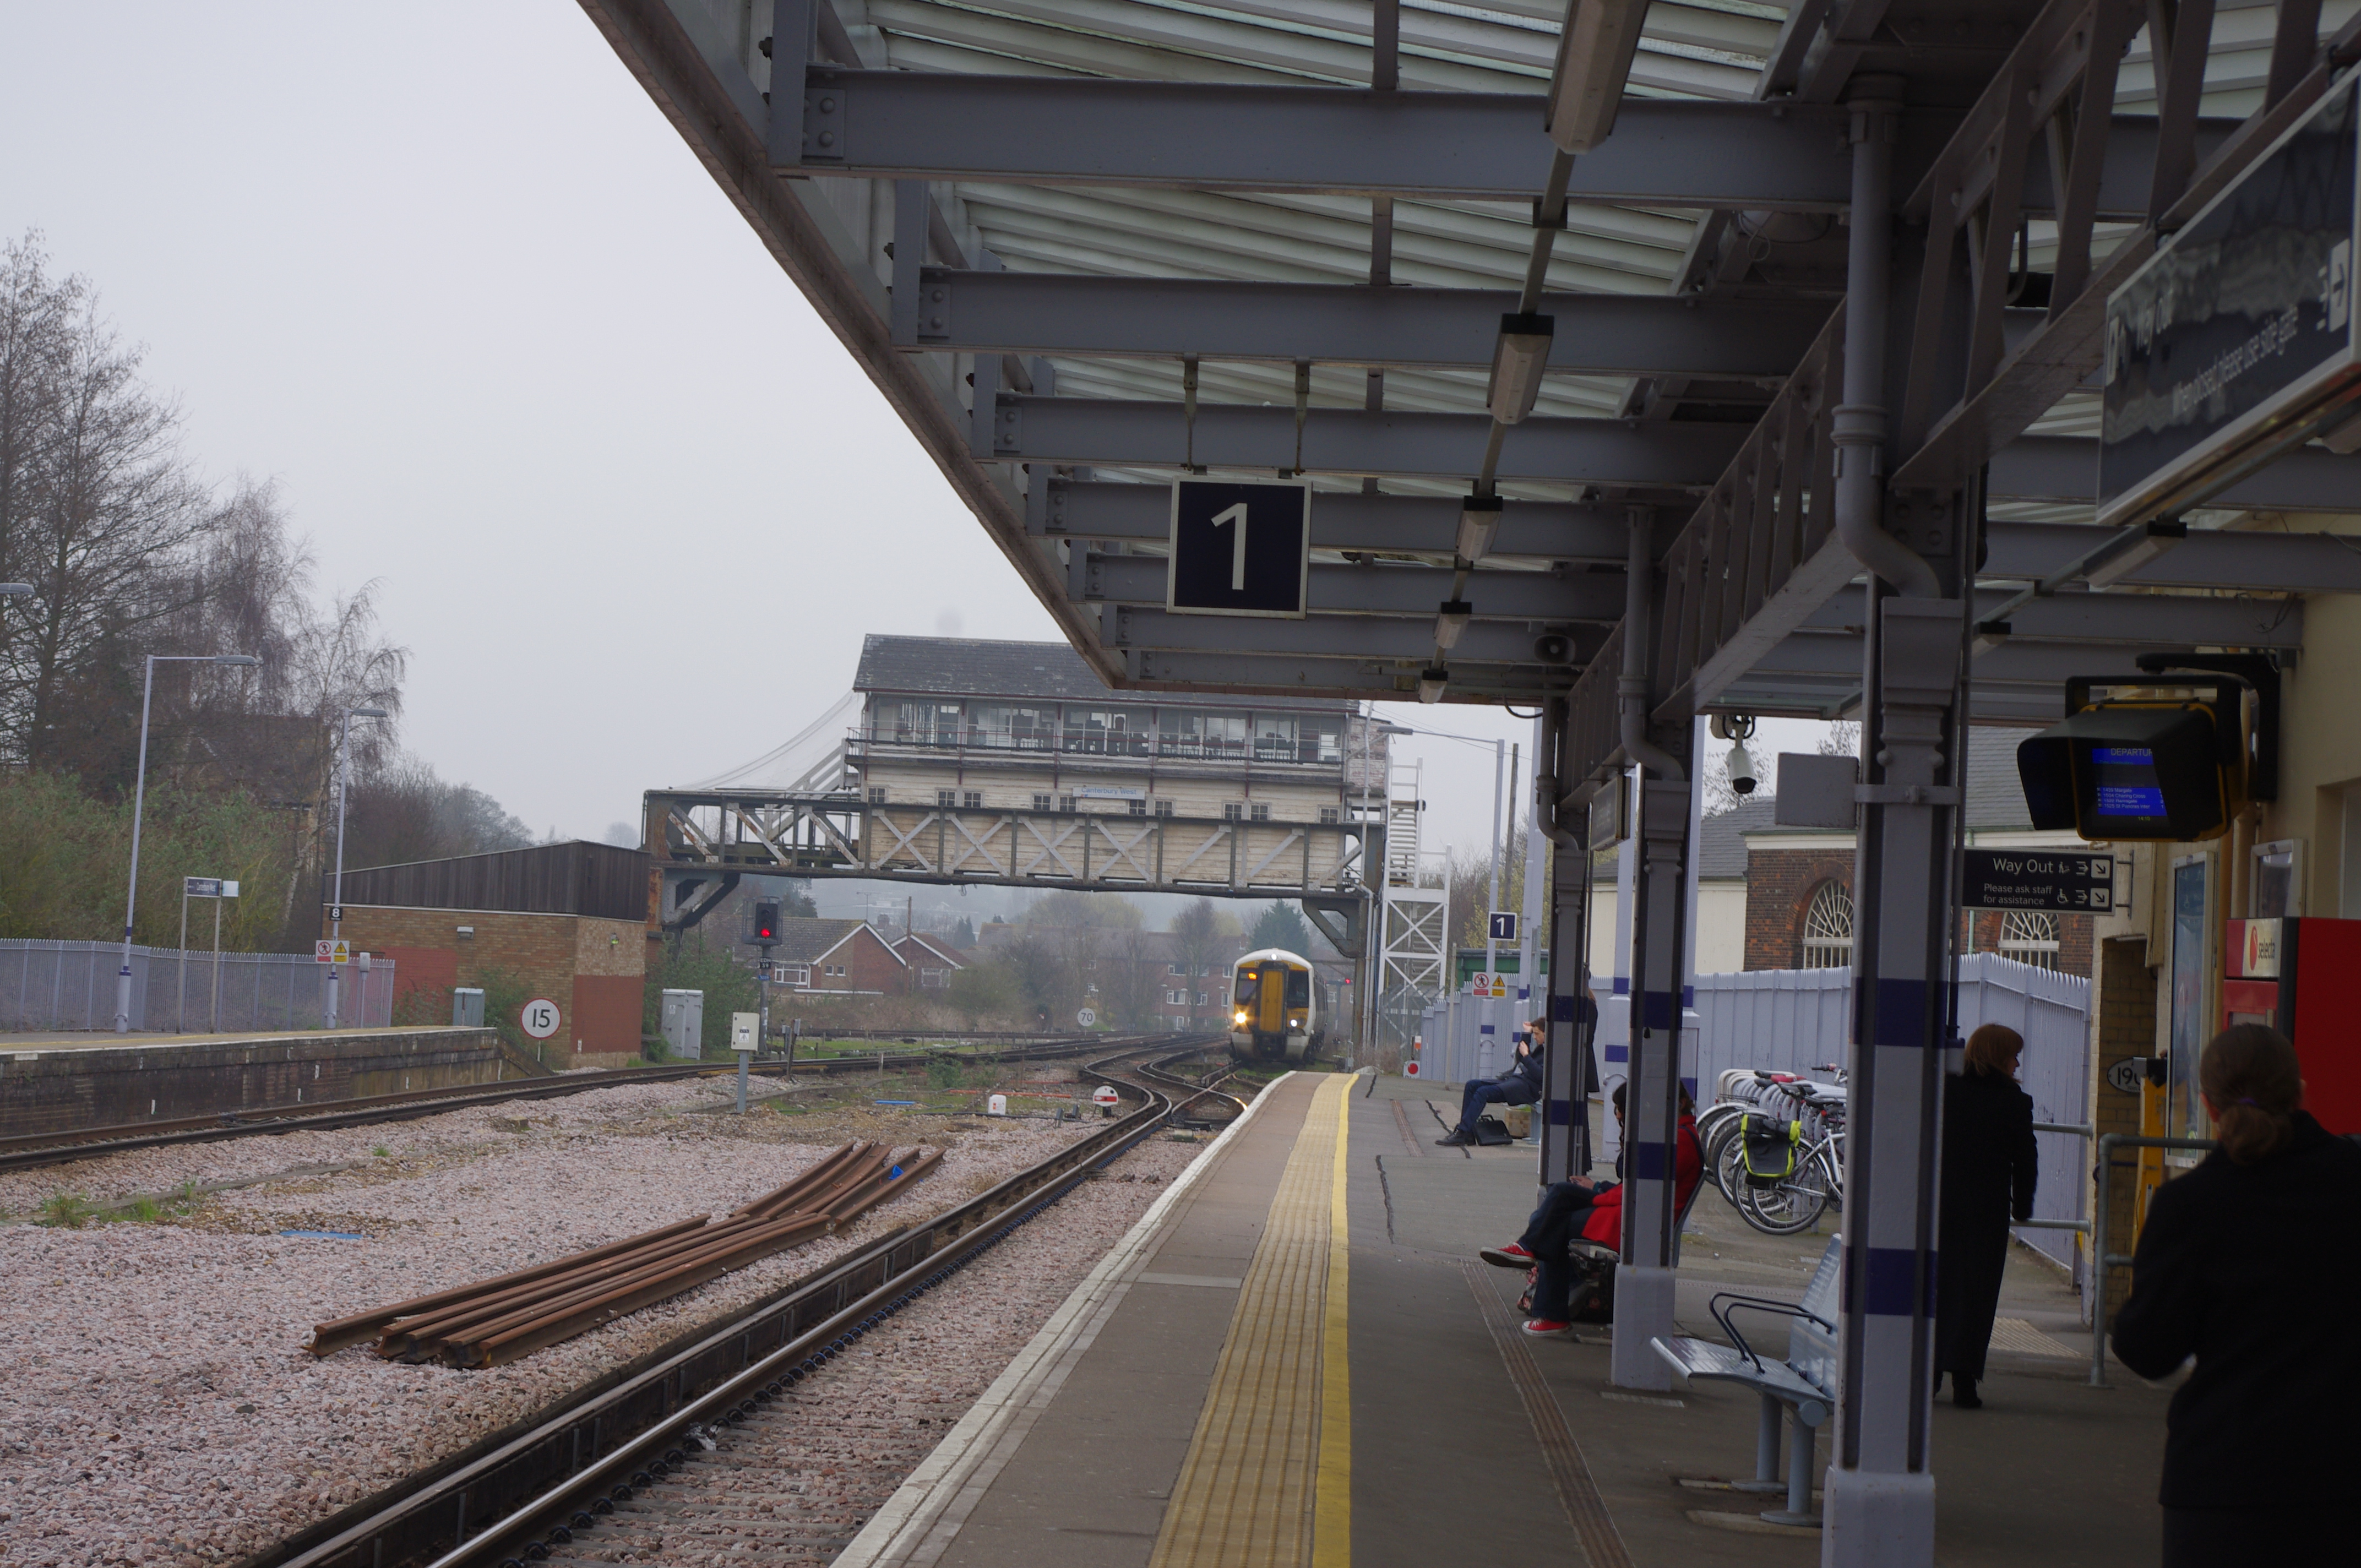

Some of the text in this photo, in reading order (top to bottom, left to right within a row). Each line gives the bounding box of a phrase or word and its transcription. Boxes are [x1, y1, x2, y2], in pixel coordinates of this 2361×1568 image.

[1210, 502, 1248, 590] 1
[1993, 858, 2054, 875] Way Out
[1984, 883, 2053, 895] Please ask staff
[1983, 895, 2044, 906] for assistance
[332, 908, 340, 917] 8
[1496, 917, 1505, 937] 1
[2258, 938, 2275, 959] selecta
[532, 1009, 550, 1028] 15
[1081, 1012, 1093, 1021] 70
